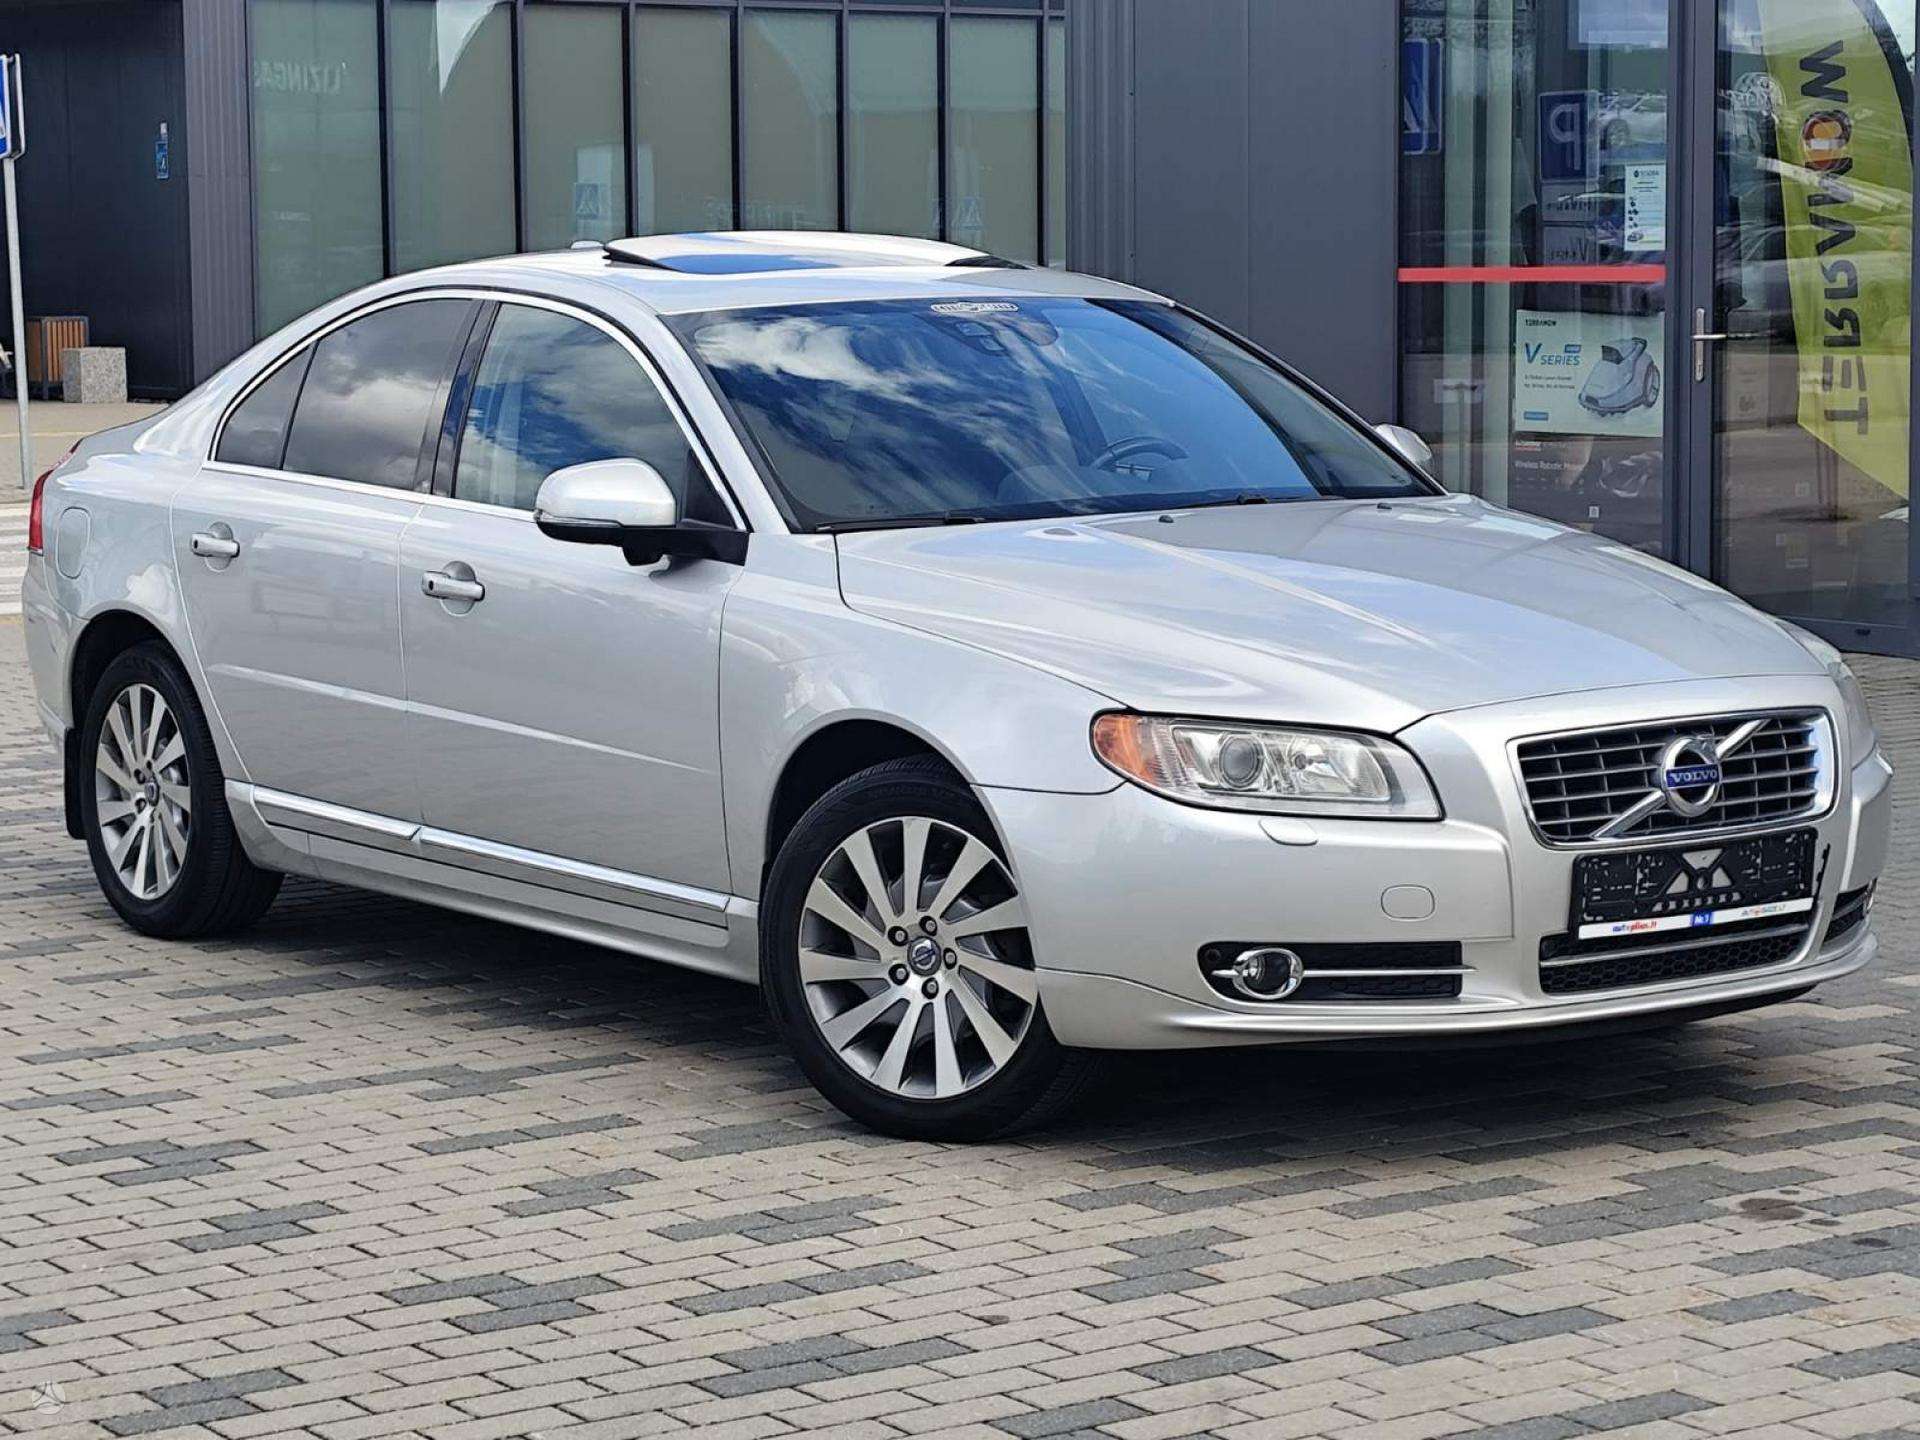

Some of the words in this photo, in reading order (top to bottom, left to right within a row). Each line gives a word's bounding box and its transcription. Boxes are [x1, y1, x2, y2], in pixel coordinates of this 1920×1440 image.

[1524, 342, 1543, 364] V
[1540, 354, 1581, 366] SERIES
[1669, 769, 1718, 783] VOLVO
